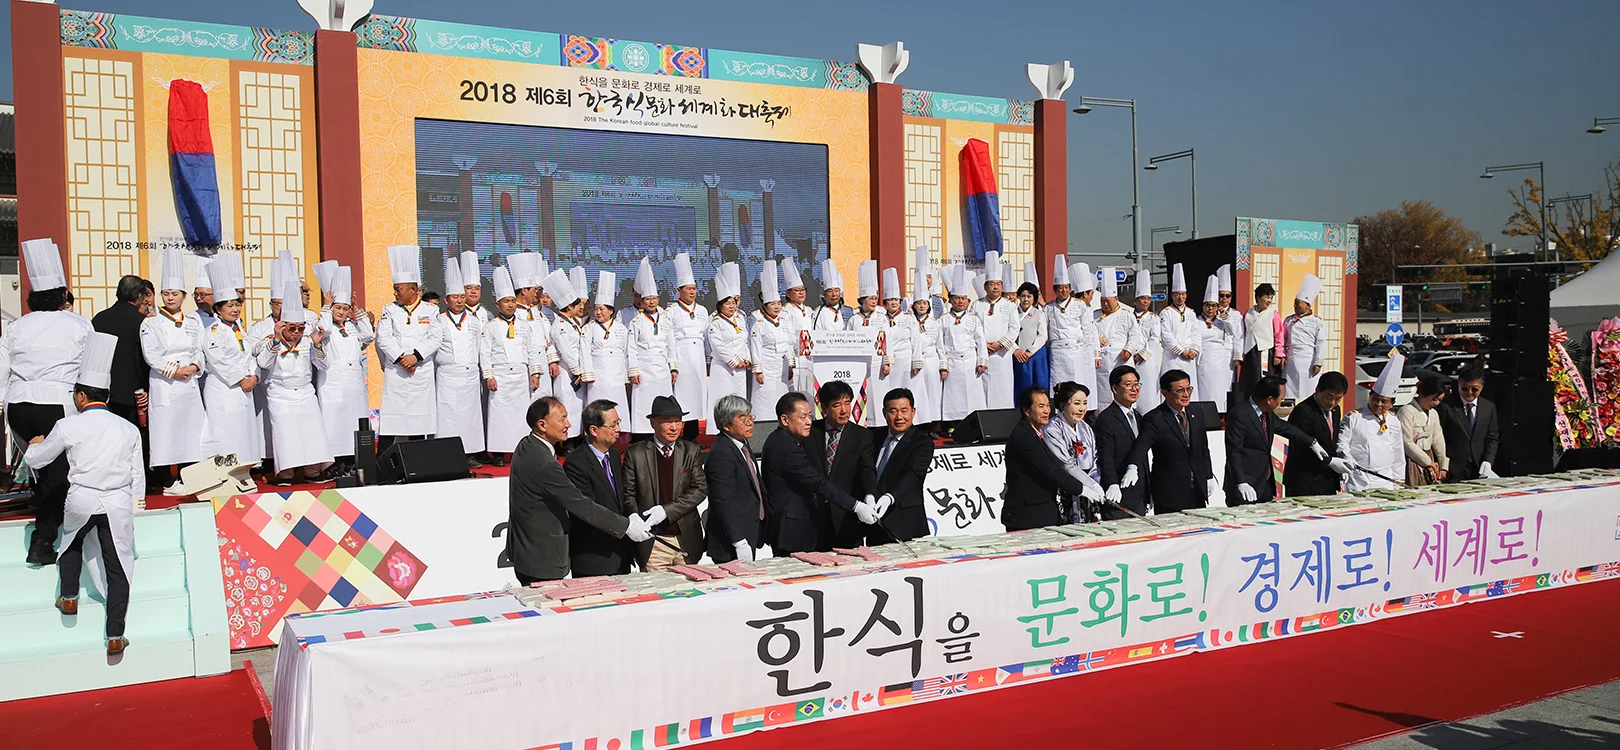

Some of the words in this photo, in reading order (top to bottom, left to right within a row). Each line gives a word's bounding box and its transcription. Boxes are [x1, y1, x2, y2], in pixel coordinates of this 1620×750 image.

[459, 79, 517, 104] 2018
[525, 86, 572, 107] 제6회
[579, 75, 607, 88] 한식을
[611, 79, 640, 90] 문화로
[644, 81, 671, 92] 경제로
[675, 83, 702, 95] 세계로
[106, 241, 132, 250] 2018
[833, 370, 851, 379] 2018
[927, 453, 973, 474] 제로
[746, 576, 981, 697] 한식을
[1016, 552, 1210, 648] 문화로!
[1238, 527, 1394, 613] 경제로!
[1412, 509, 1543, 584] 세계로!
